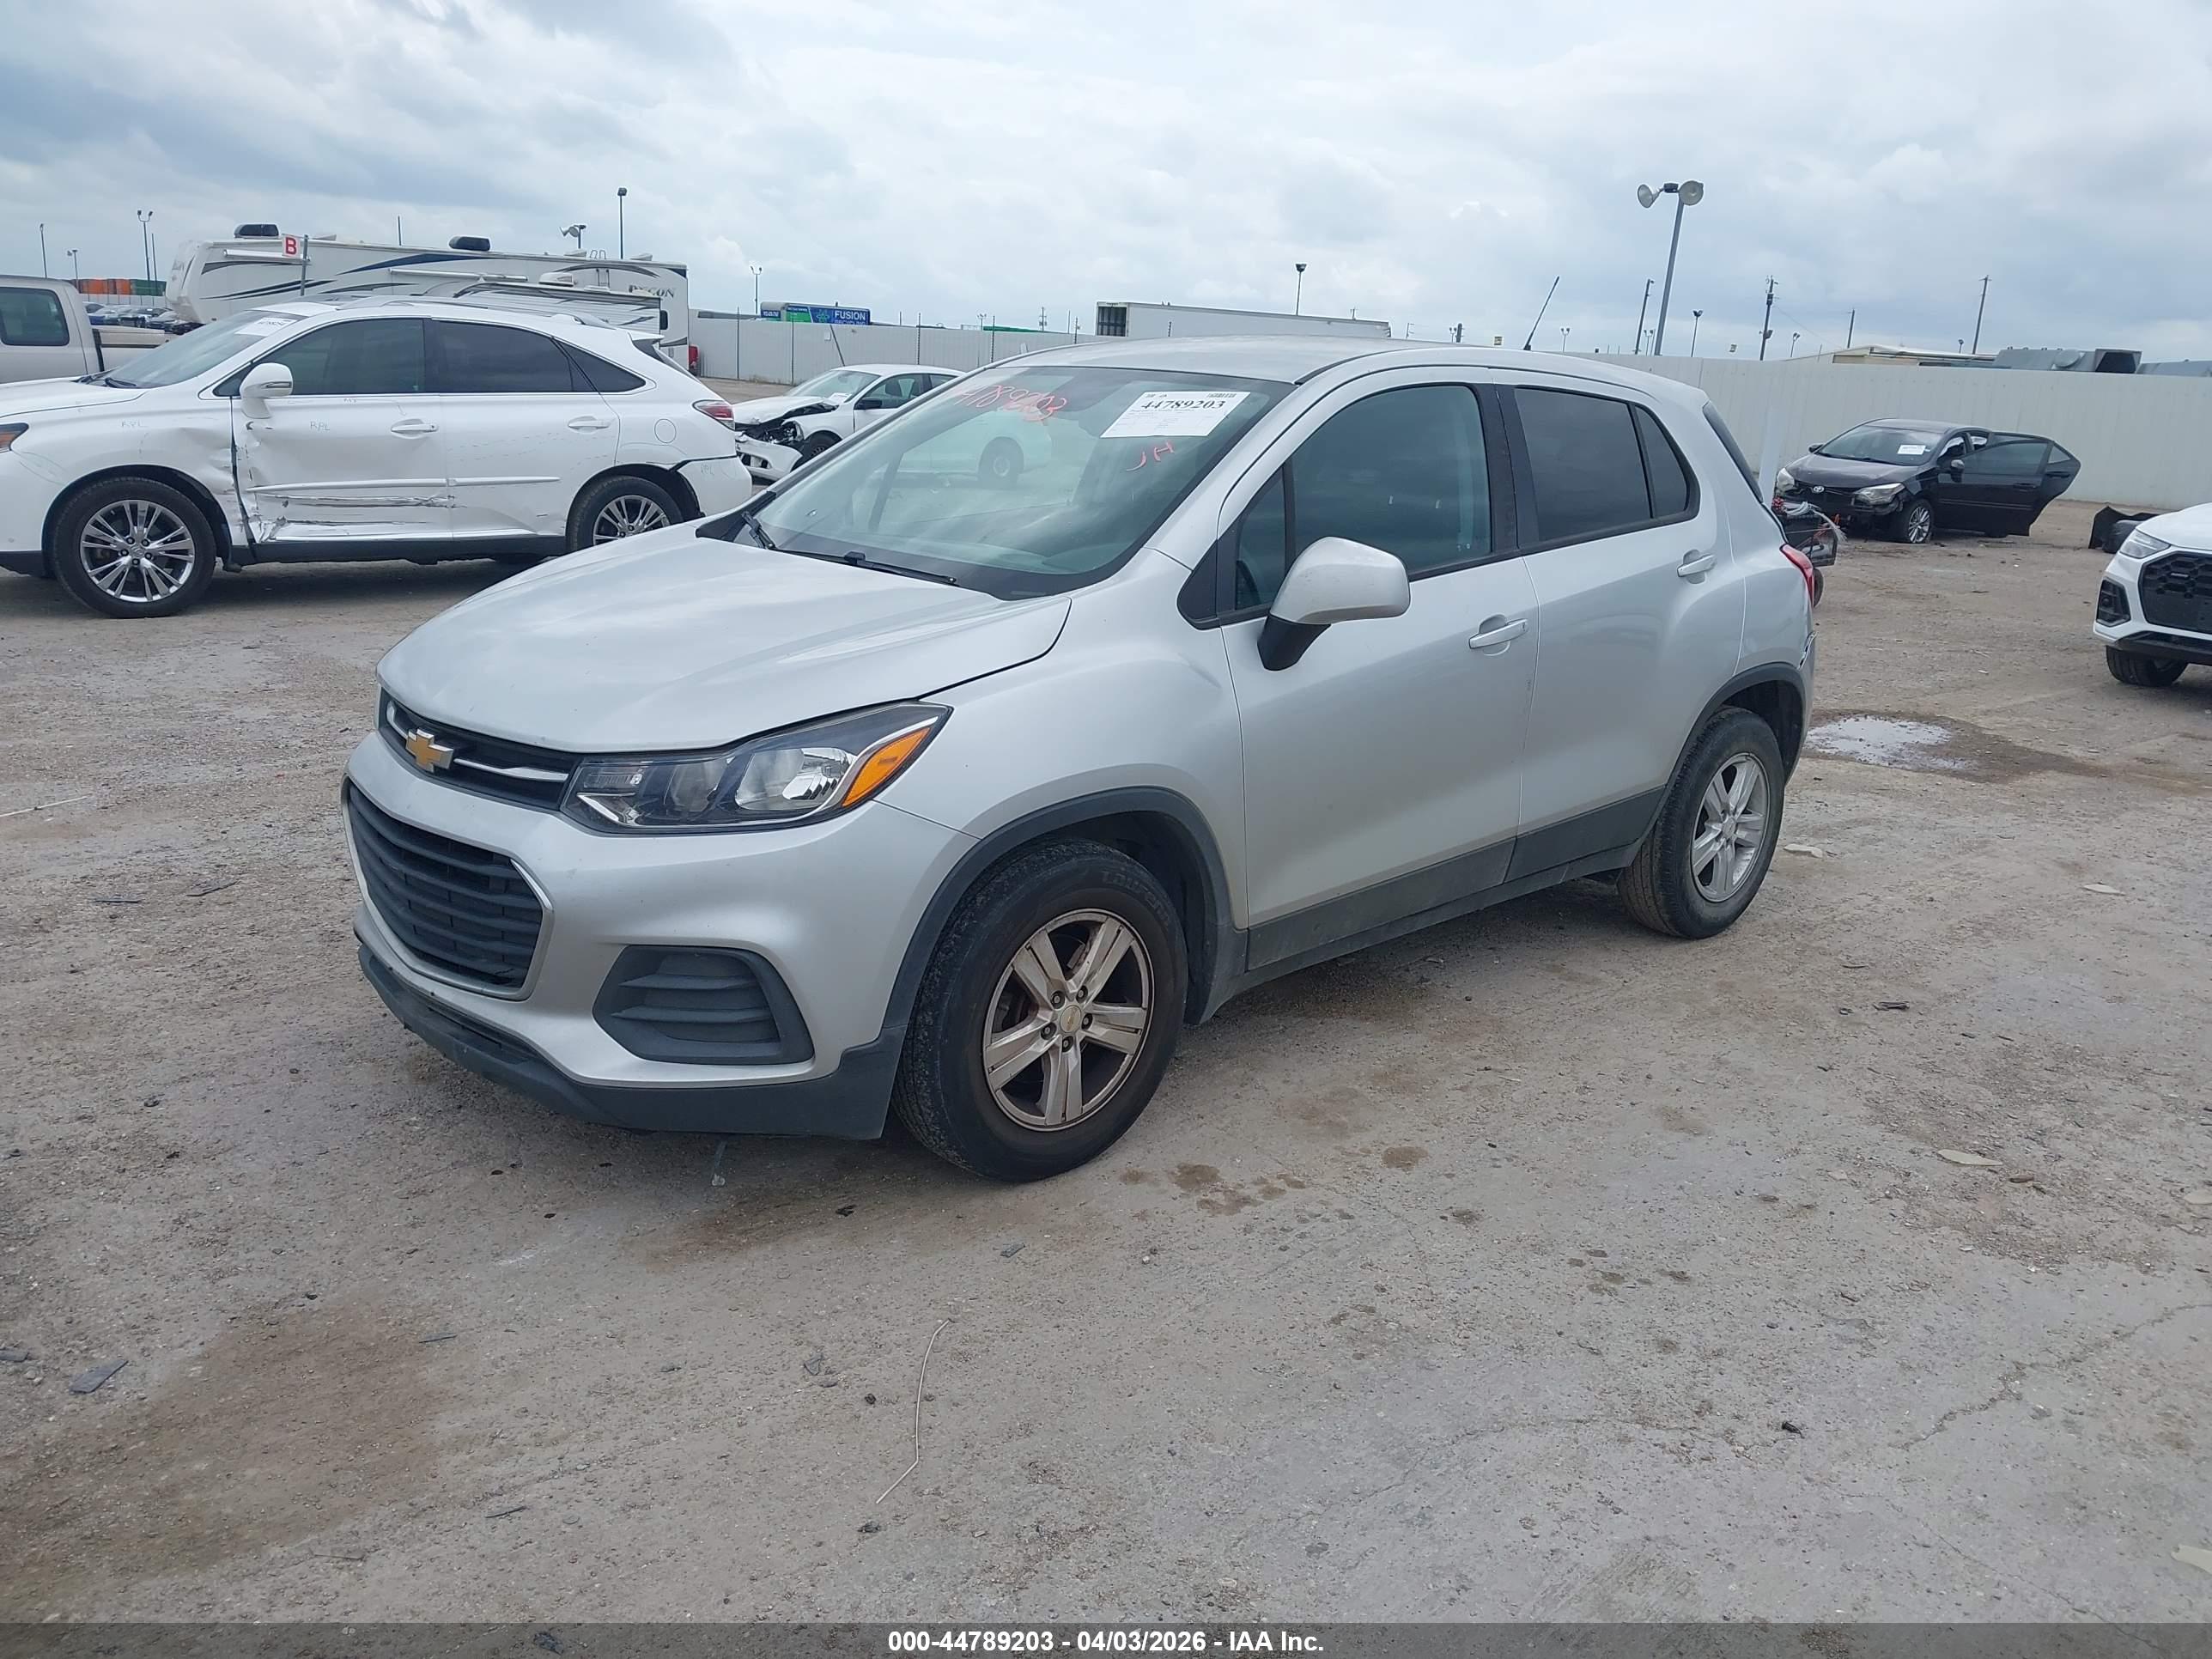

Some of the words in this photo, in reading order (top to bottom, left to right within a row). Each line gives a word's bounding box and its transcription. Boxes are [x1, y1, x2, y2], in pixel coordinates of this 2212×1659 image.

[286, 237, 297, 254] B
[835, 310, 866, 320] FUSION
[1140, 400, 1226, 410] 44789203
[310, 421, 331, 431] RPL
